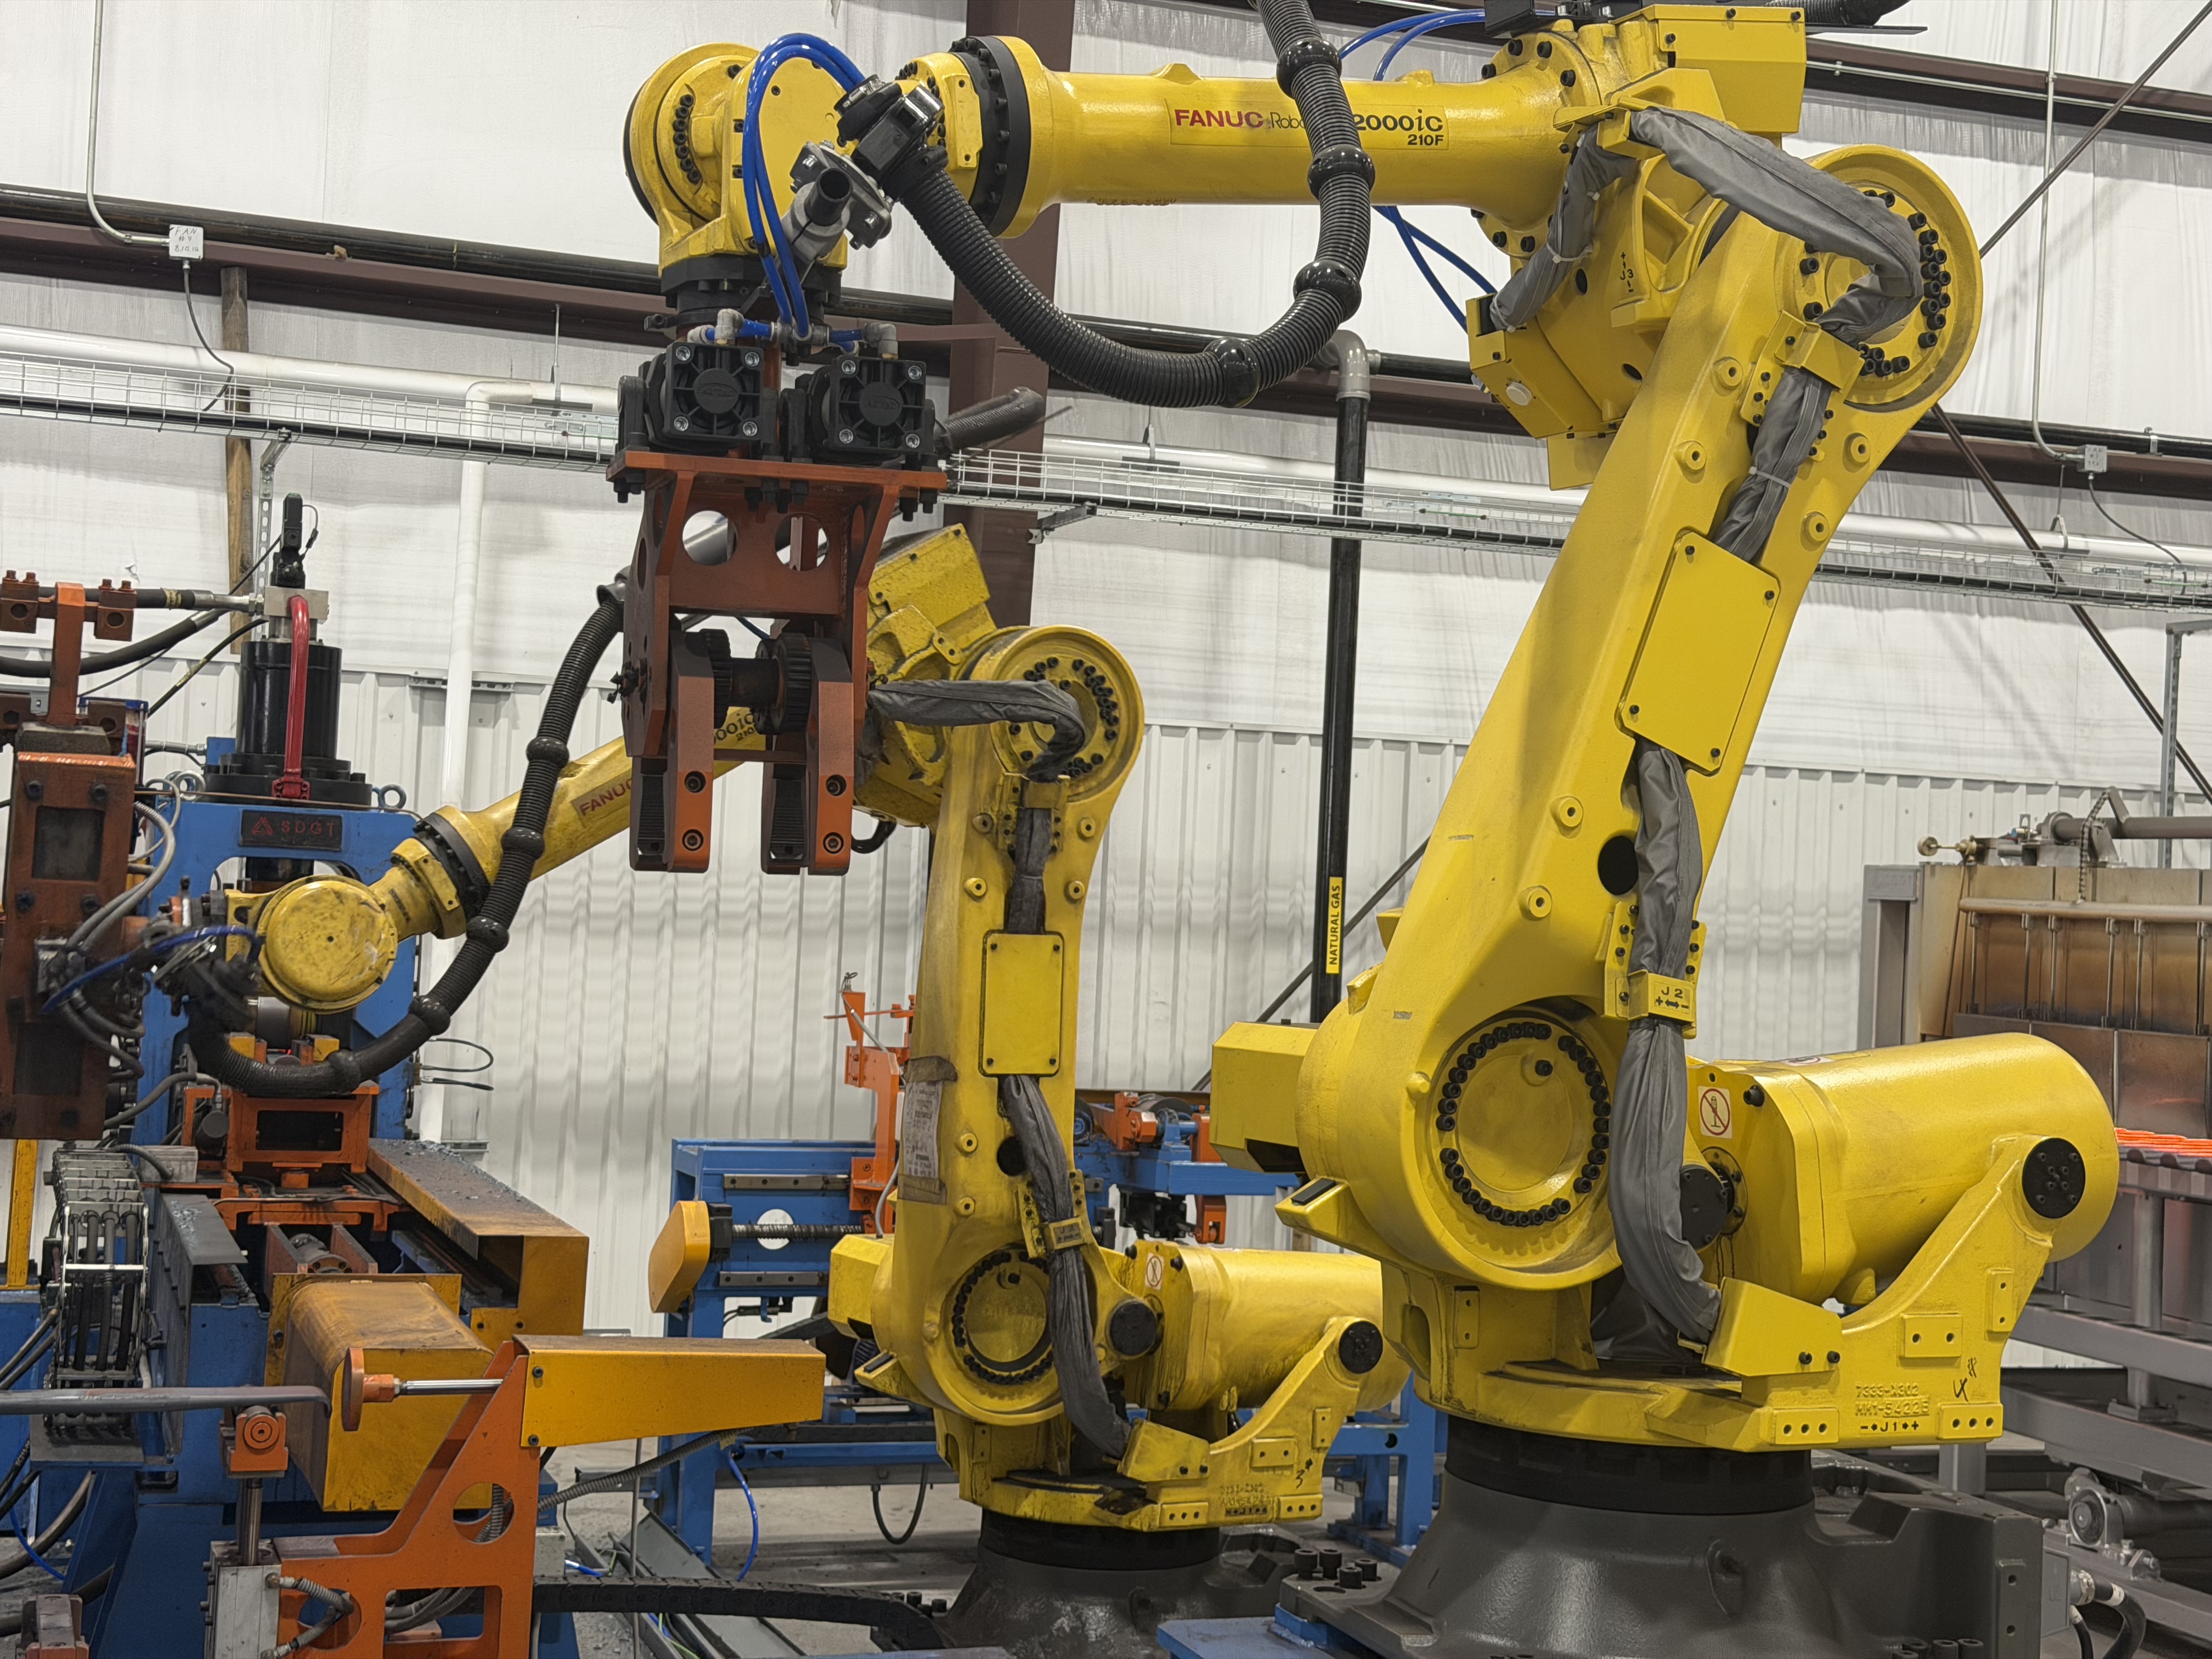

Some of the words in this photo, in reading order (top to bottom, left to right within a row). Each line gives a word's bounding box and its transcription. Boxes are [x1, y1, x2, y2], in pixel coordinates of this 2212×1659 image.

[1175, 109, 1263, 128] FANUC
[1407, 134, 1444, 146] 210F
[175, 226, 198, 236] FAN
[1620, 268, 1634, 280] J3
[1331, 885, 1340, 909] GAS
[1329, 911, 1340, 965] NATURAL
[1880, 1421, 1898, 1432] J1
